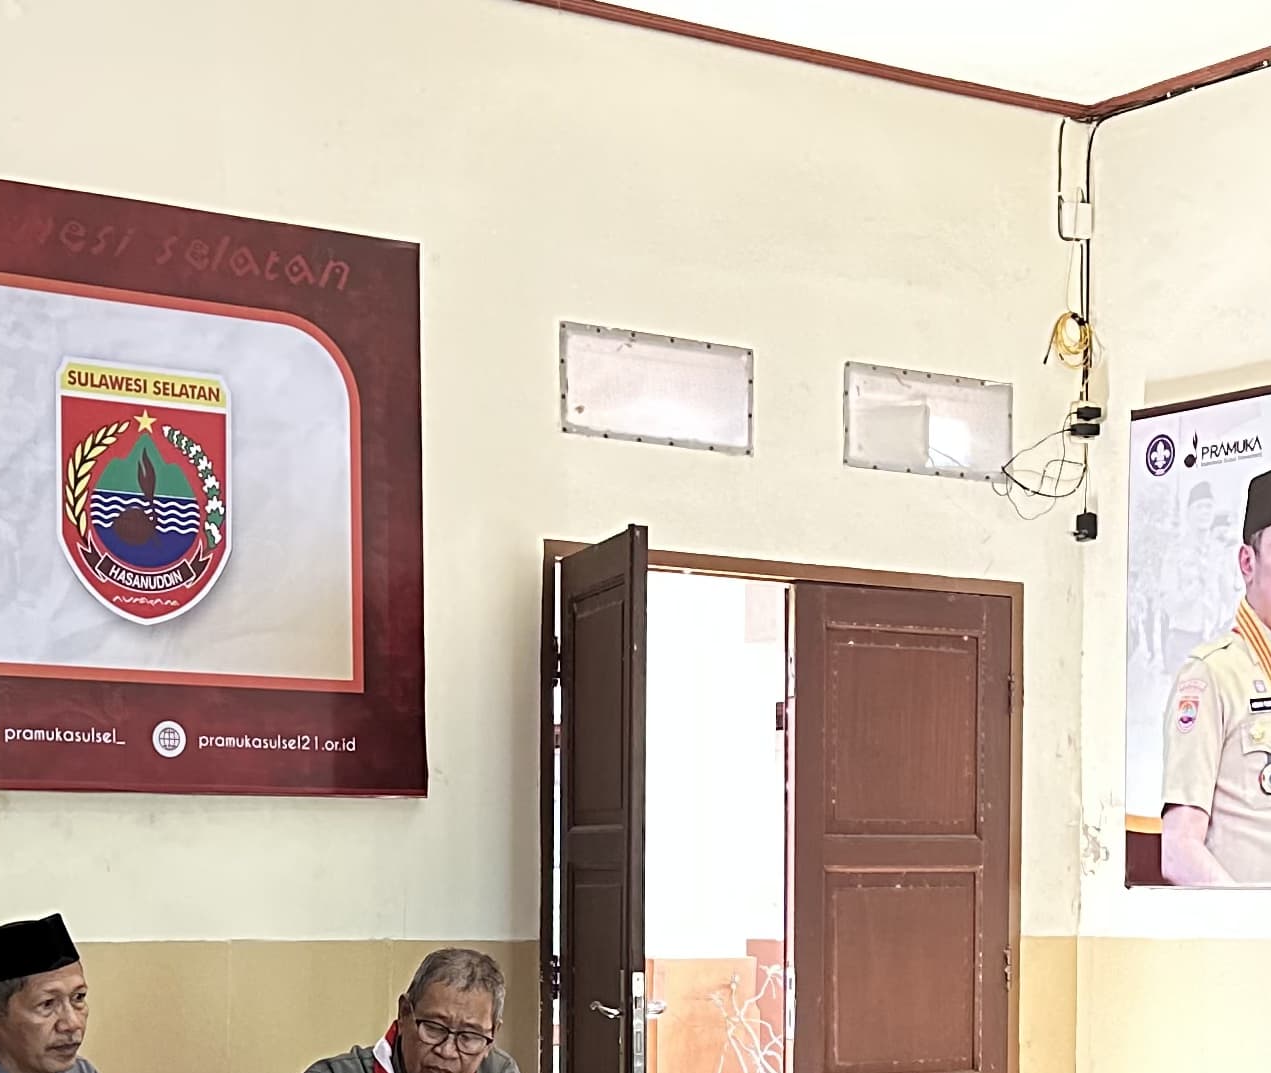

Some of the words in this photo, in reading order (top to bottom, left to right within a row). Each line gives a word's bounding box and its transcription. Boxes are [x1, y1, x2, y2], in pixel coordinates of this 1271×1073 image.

[68, 370, 147, 394] SULAWESI
[153, 380, 220, 402] SELATAN
[1201, 435, 1262, 460] PRAMUKA
[109, 565, 183, 590] HASANUDDIN
[4, 727, 125, 745] pramukasulsel_
[199, 734, 356, 752] pramukasulsel21.or.id
